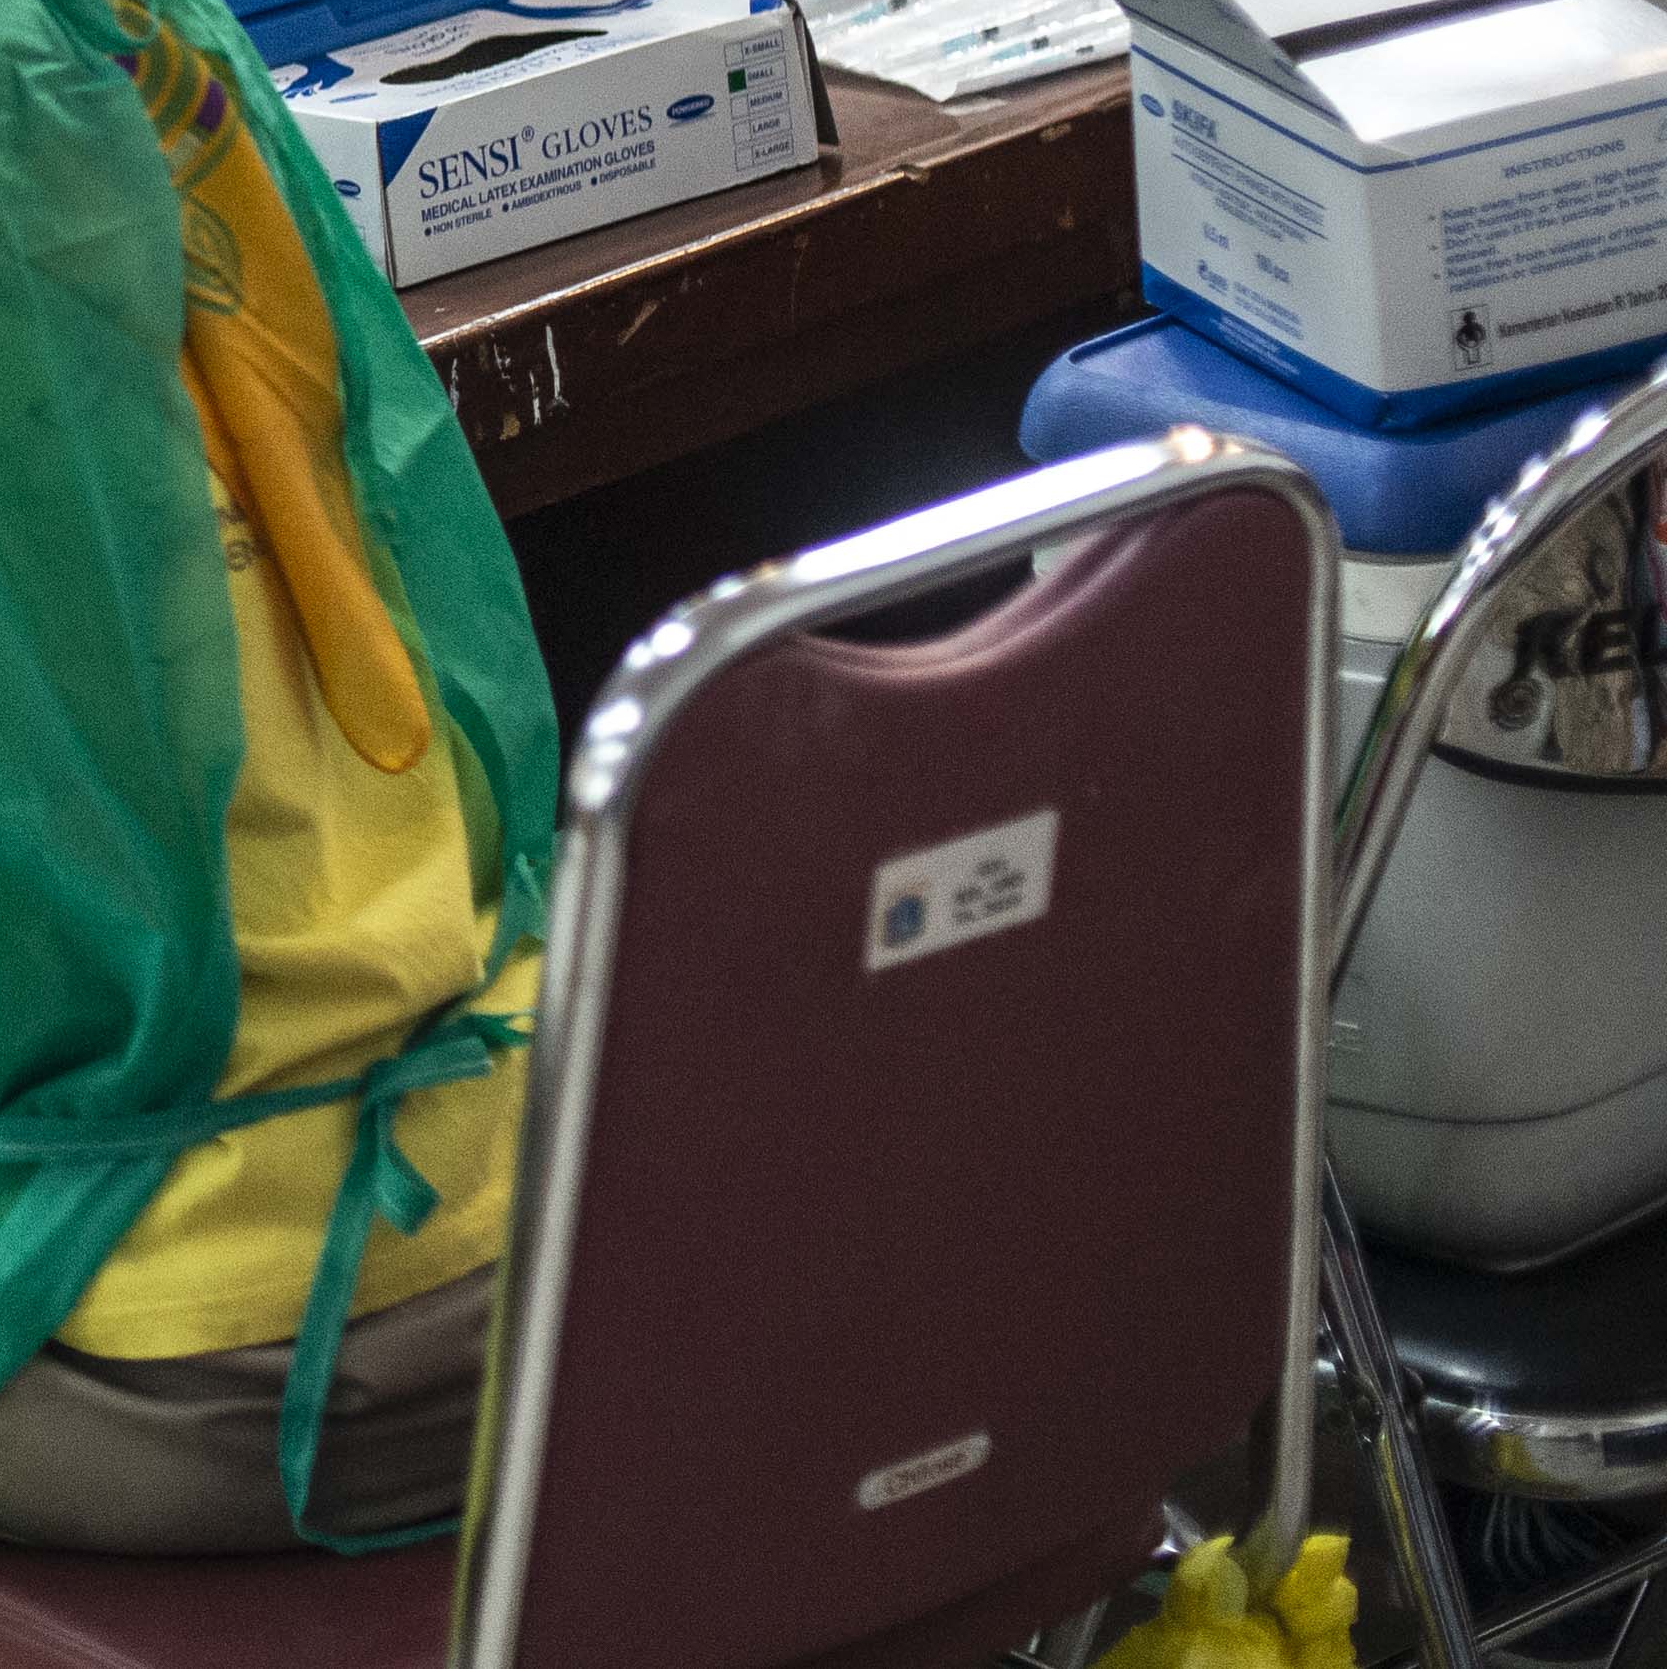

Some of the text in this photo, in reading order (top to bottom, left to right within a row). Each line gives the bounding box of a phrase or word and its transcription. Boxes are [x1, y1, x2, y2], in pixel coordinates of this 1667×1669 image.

[542, 106, 654, 160] GLOVES
[1503, 139, 1627, 179] INSTRUCTIONS
[421, 140, 655, 223] MEDICAL LATEX EXAMINATION GLOVES
[433, 158, 657, 236] NON STERILE AMBIDEXTROUS DISPOSABLE
